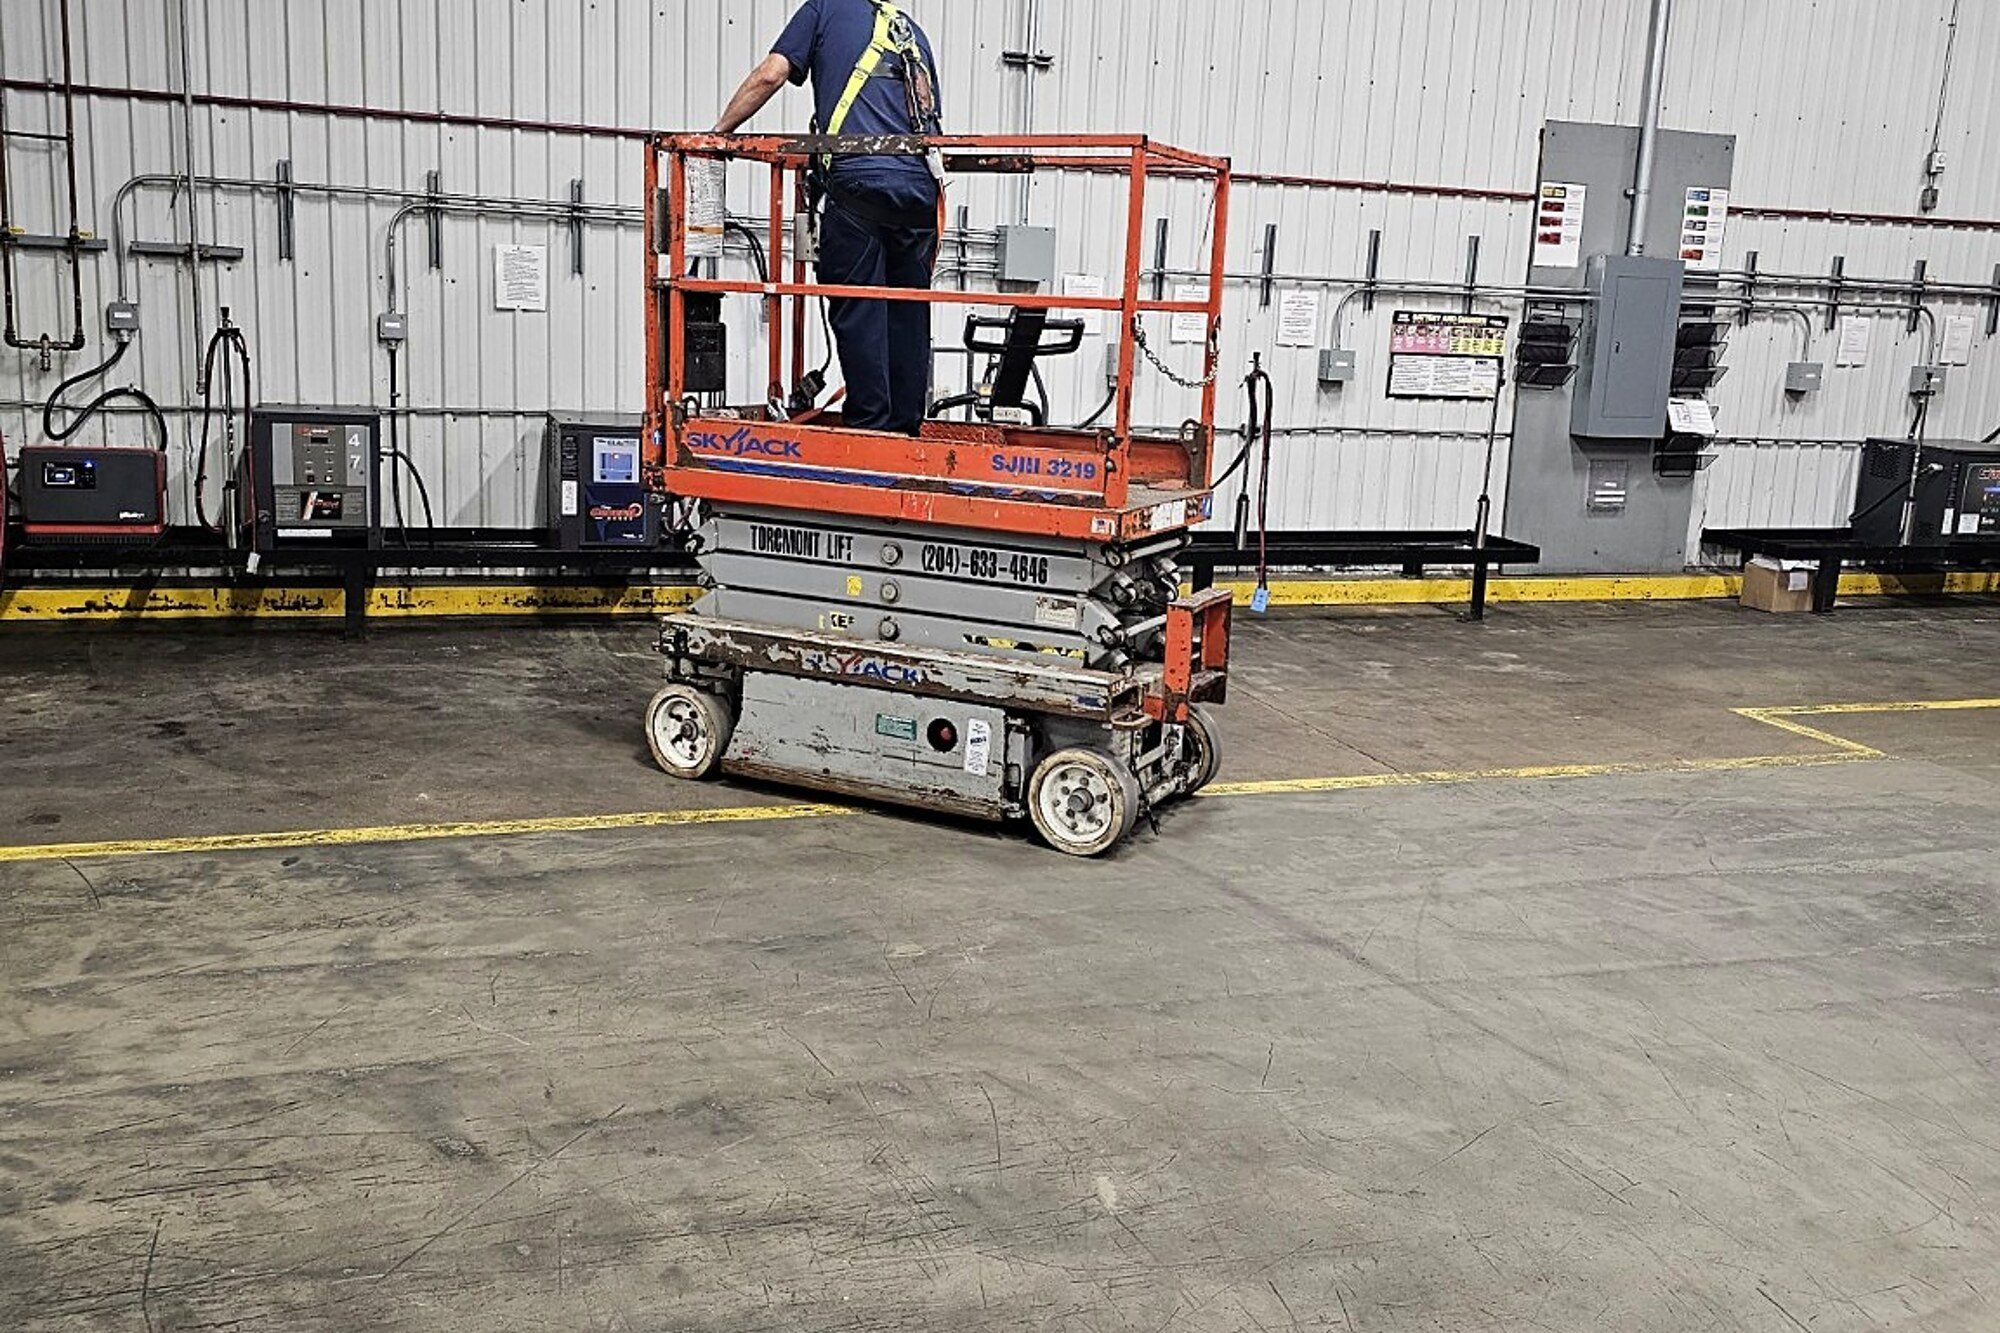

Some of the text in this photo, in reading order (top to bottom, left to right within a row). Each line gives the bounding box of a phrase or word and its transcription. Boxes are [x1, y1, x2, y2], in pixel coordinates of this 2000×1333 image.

[687, 427, 802, 457] SKYJACK
[1047, 458, 1096, 480] 3219
[827, 532, 854, 561] LIFT
[921, 544, 1048, 584] (204)-633-4646
